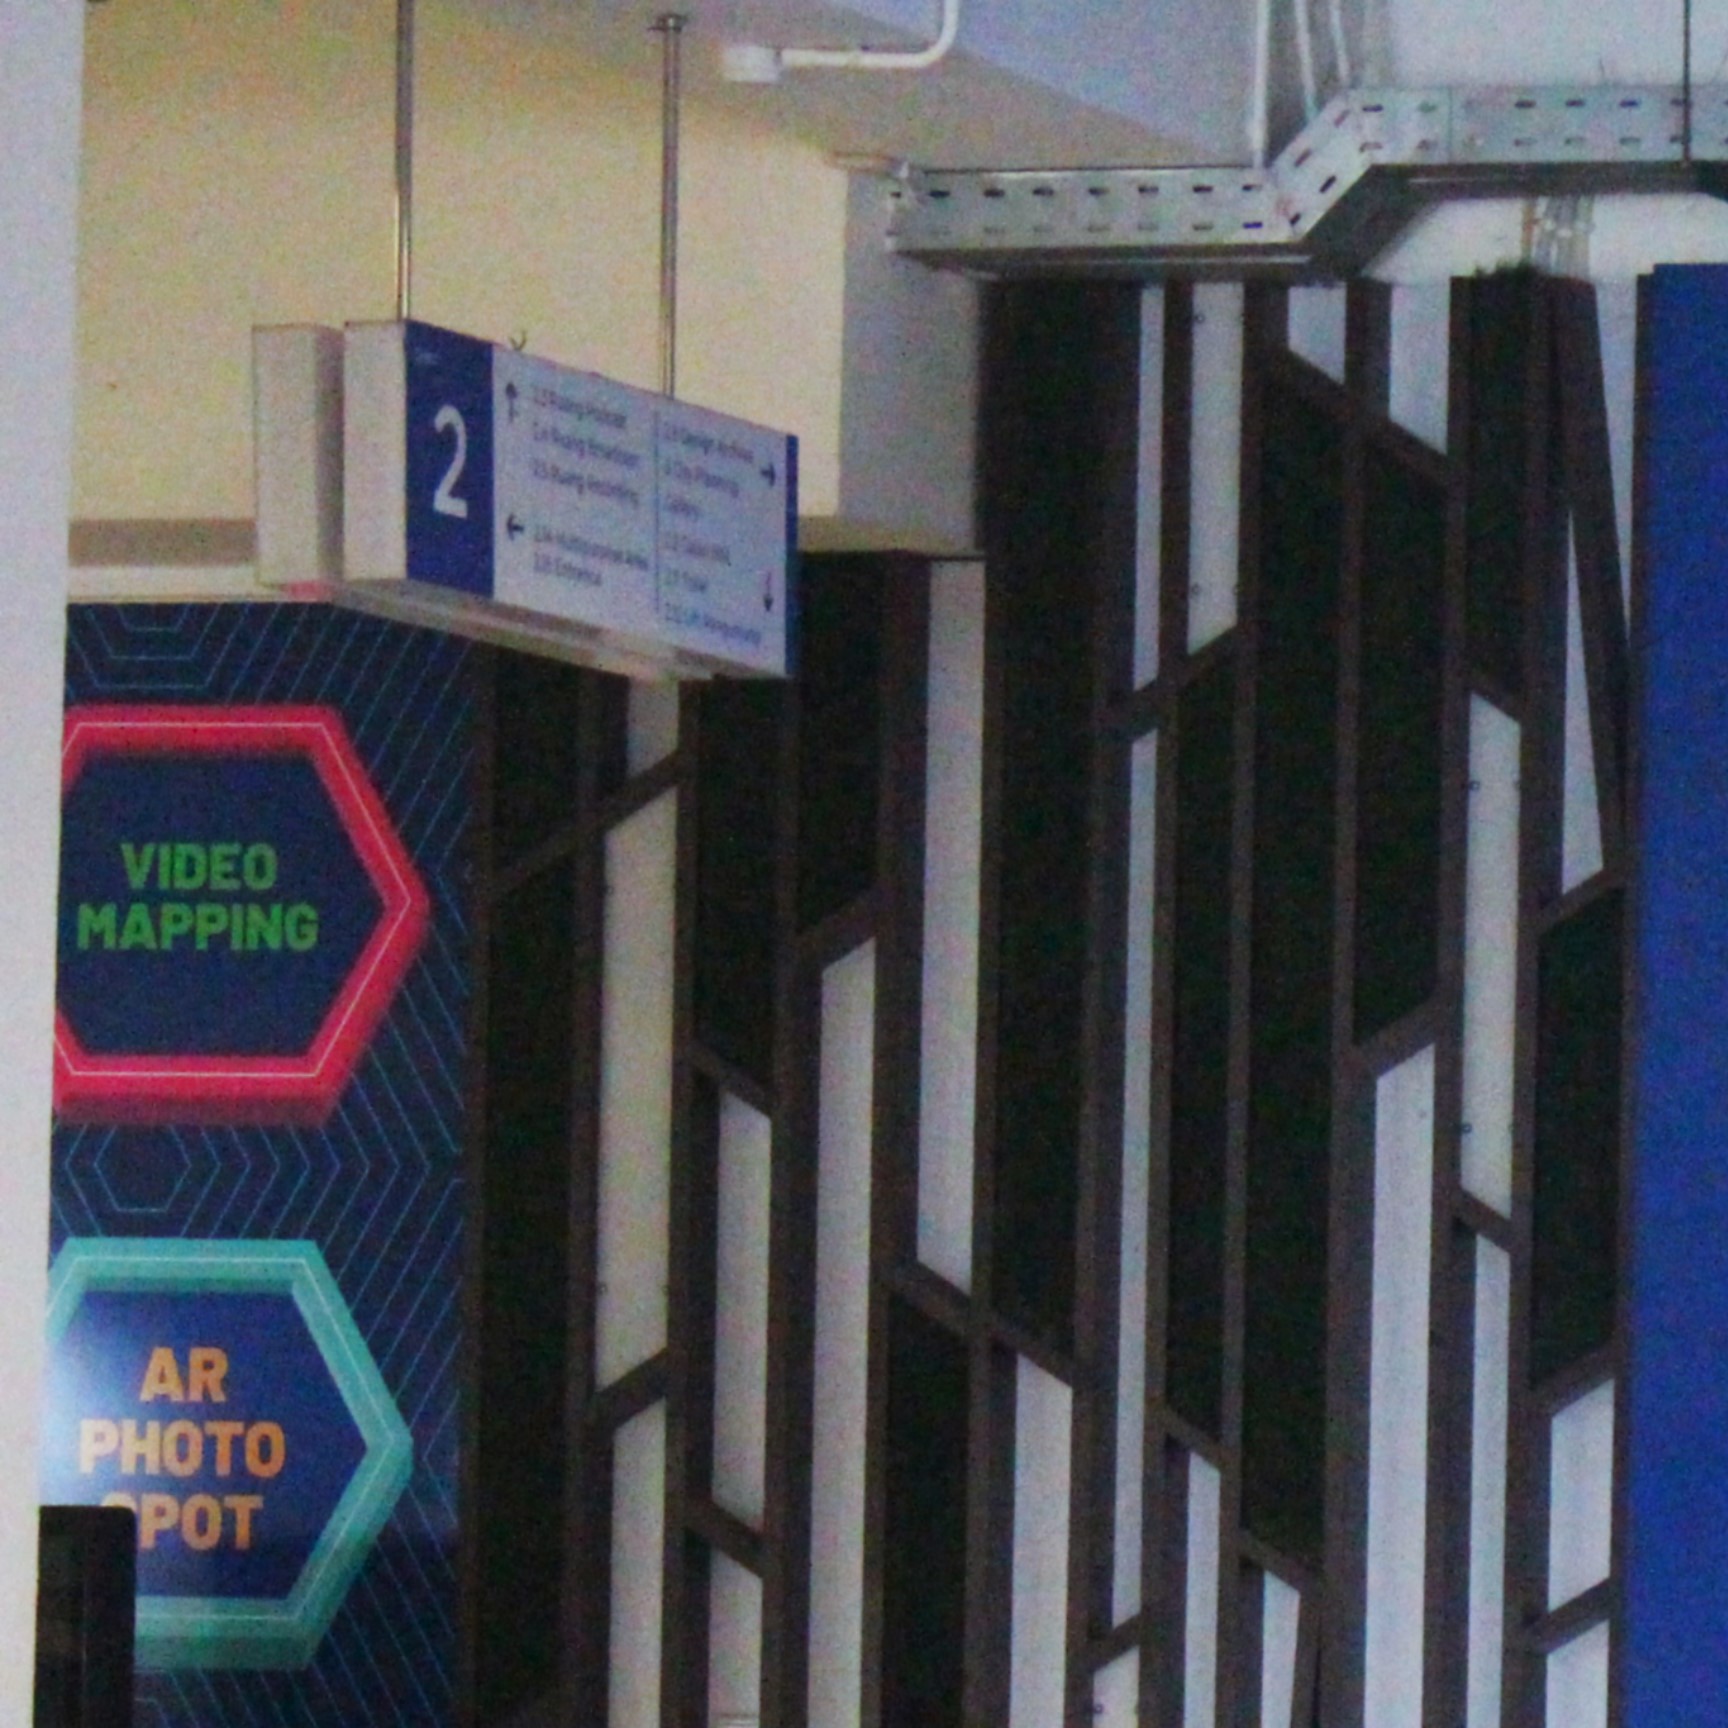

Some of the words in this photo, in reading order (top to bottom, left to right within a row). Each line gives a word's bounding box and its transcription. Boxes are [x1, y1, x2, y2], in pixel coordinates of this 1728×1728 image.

[433, 404, 468, 519] 2
[120, 842, 278, 891] VIDEO
[76, 902, 319, 952] MAPPING
[139, 1346, 229, 1403] AR
[79, 1417, 286, 1478] PHOTO
